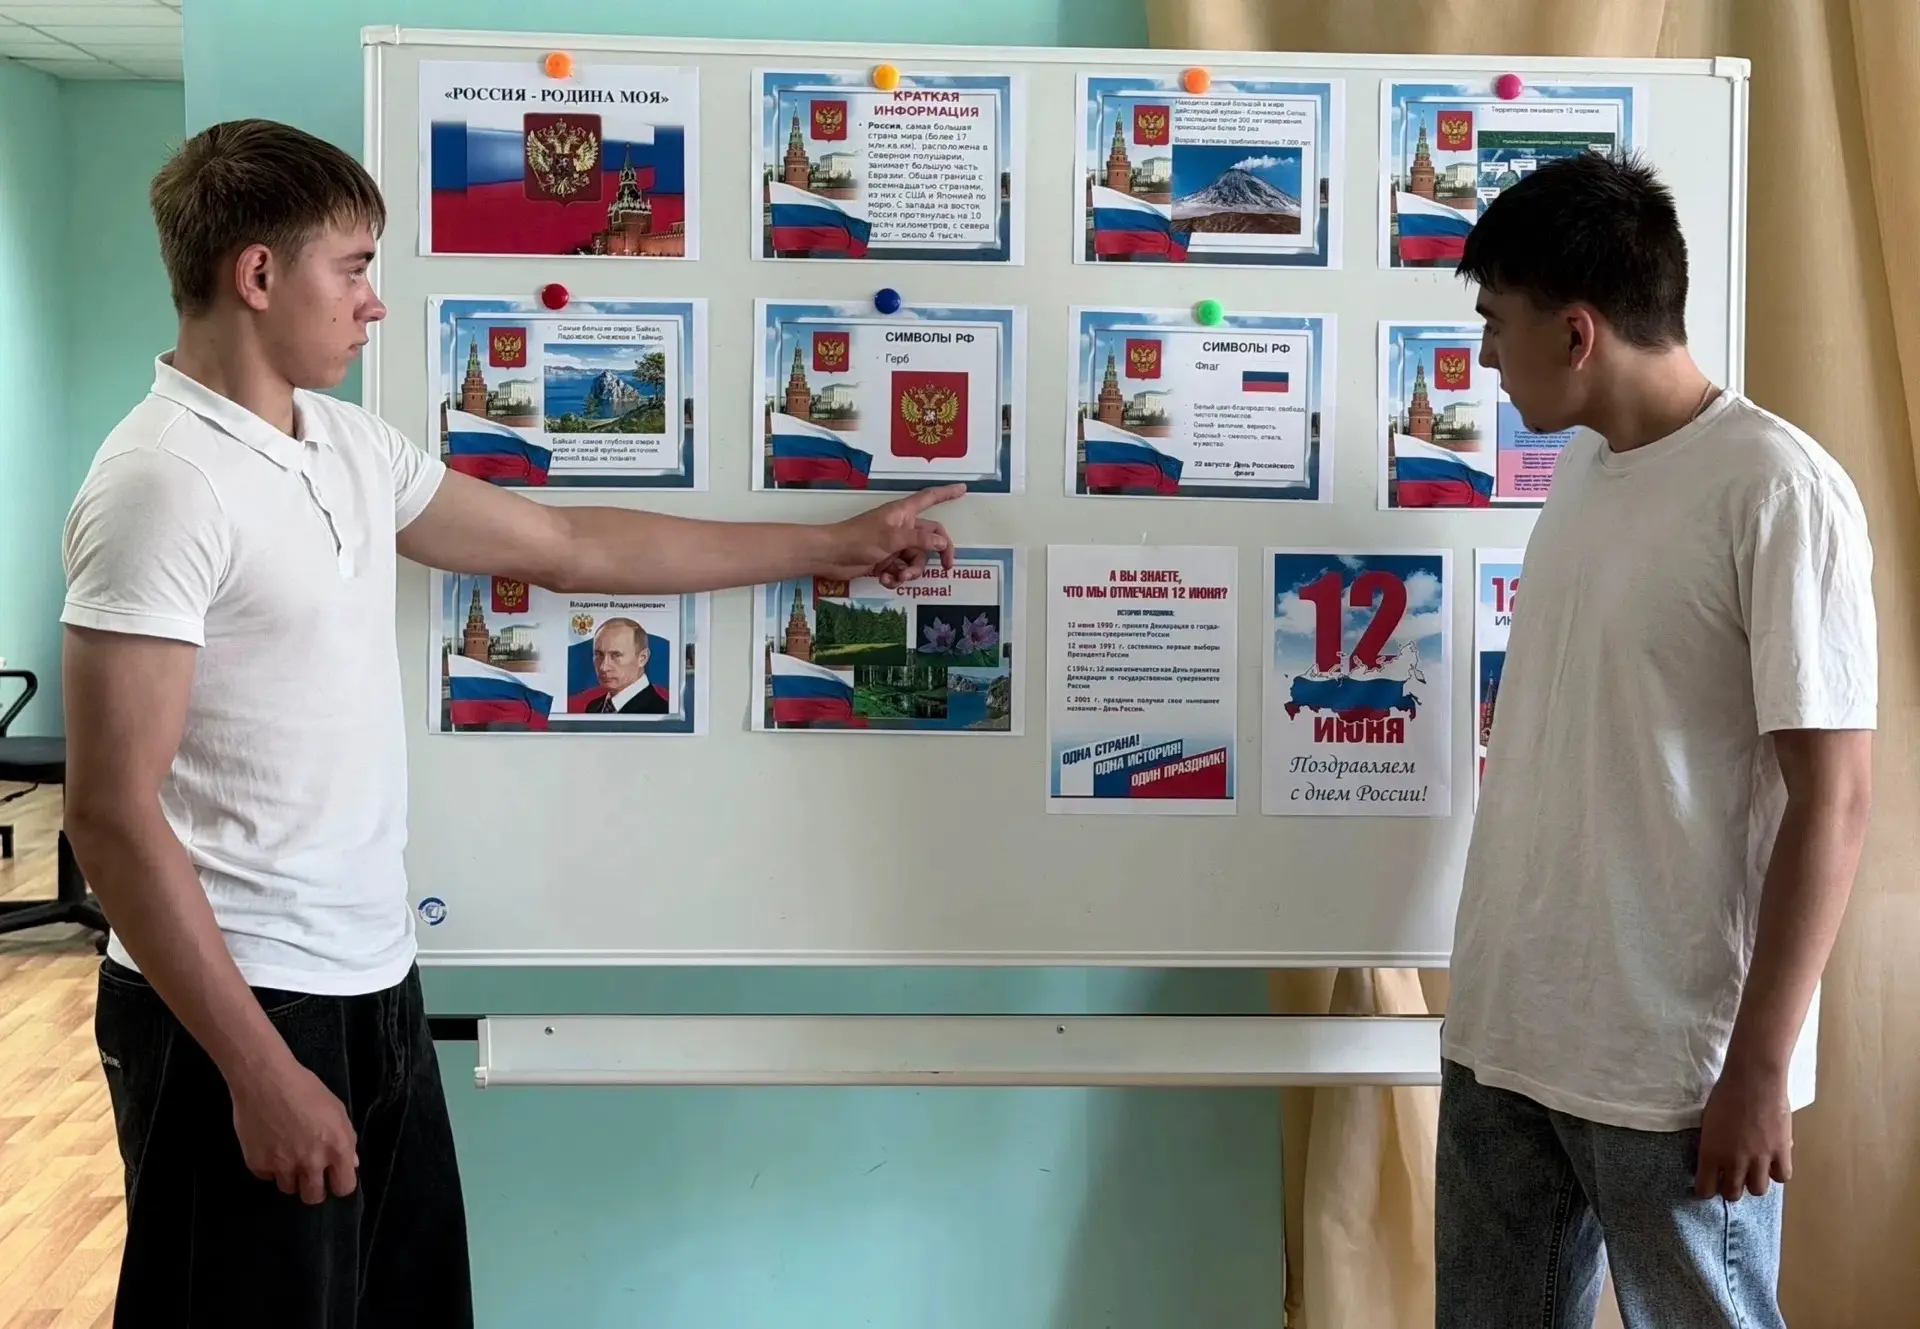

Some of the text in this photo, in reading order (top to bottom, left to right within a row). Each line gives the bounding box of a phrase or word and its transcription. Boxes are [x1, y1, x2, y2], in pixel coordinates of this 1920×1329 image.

[444, 87, 669, 105] «РОССИЯ РОДИНА МОЯ»
[893, 91, 960, 102] КРАТКАЯ
[873, 105, 979, 118] ИНФОРМАЦИЯ
[868, 122, 903, 130] Россия,
[933, 123, 972, 131] большая
[900, 133, 922, 141] мира
[925, 133, 954, 141] (более
[957, 133, 967, 141] 17
[922, 143, 980, 151] расположена
[868, 151, 965, 161] Северном полушарии,
[912, 162, 951, 171] большую
[868, 172, 906, 180] Евразии.
[909, 172, 938, 181] Общая
[940, 174, 976, 182] граница
[939, 183, 983, 191] странами,
[936, 192, 973, 200] Японией
[896, 201, 903, 209] С
[868, 210, 897, 218] Россия
[900, 212, 955, 220] протянулась
[971, 212, 981, 220] 10
[896, 222, 951, 230] километров,
[885, 332, 975, 344] СИМВОЛЫ РФ
[1202, 341, 1290, 354] СИМВОЛЫ РФ
[885, 353, 909, 365] Герб
[1195, 362, 1220, 371] Флаг
[953, 569, 991, 579] наша
[1109, 570, 1182, 584] А ВЫ ЗНАЕТЕ,
[896, 585, 952, 599] страна!
[1063, 586, 1228, 599] ЧТО МЫ ОТМЕЧАЕМ 12 ИЮНЯ?
[570, 601, 665, 609] Владимир Владимирович
[1299, 570, 1408, 673] 12
[1314, 716, 1405, 743] ИЮНЯ
[1063, 734, 1140, 765] ОДНА СТРАНА!
[1095, 741, 1182, 775] ОДНА ИСТОРИЯ!
[1131, 751, 1225, 787] ОДИН ПРАЗДНИК!
[1289, 754, 1416, 779] Поздравляем
[1290, 781, 1428, 802] с днем России!
